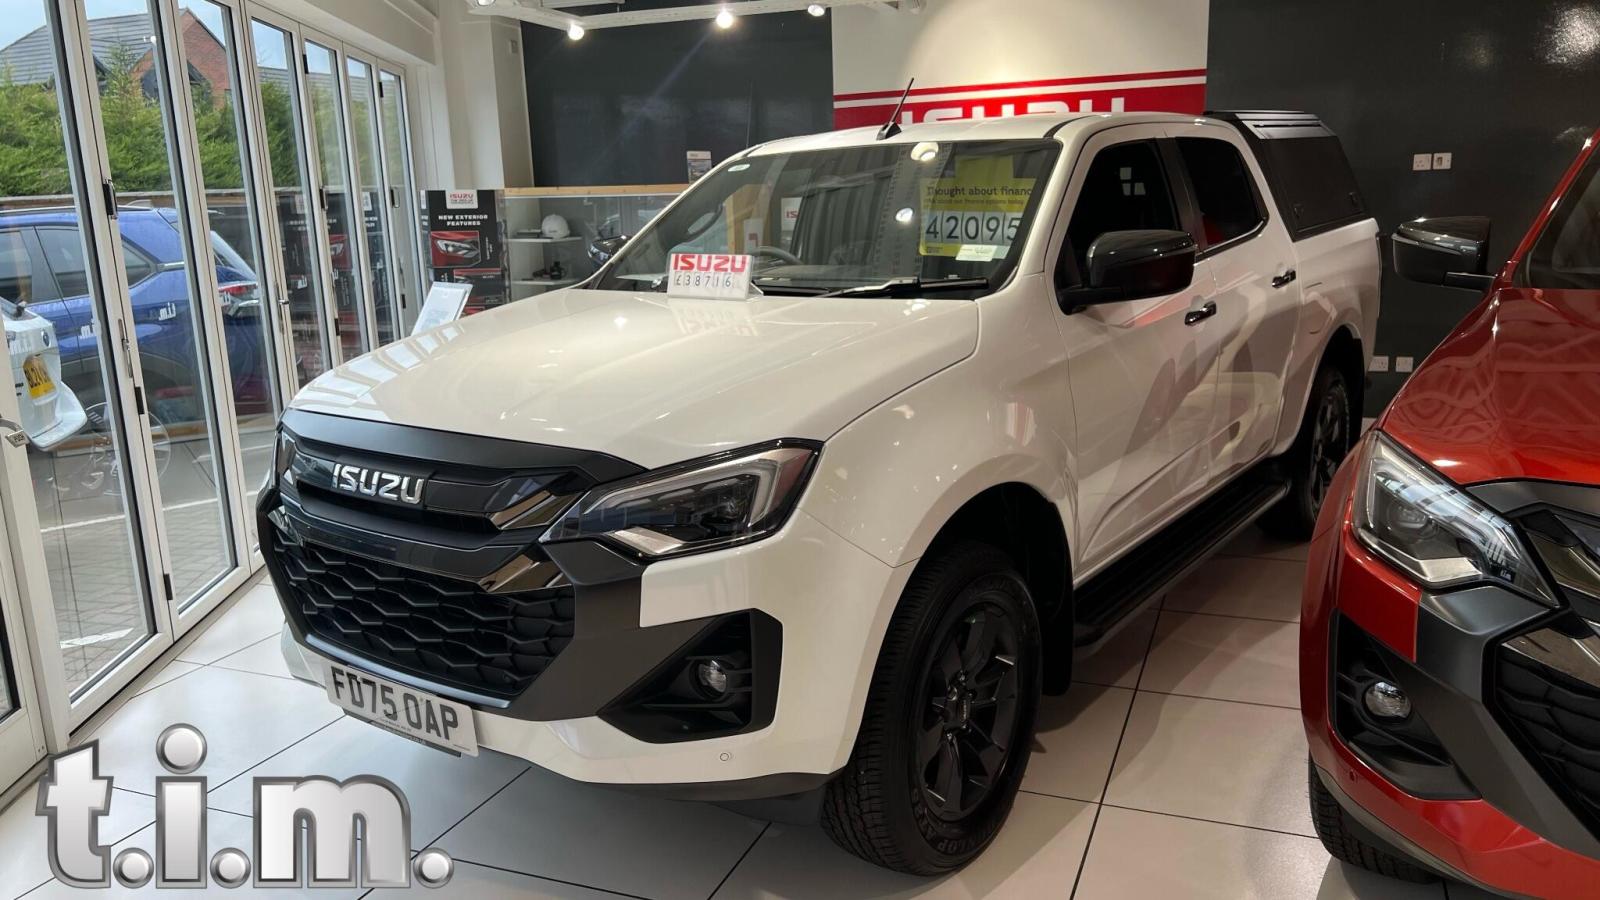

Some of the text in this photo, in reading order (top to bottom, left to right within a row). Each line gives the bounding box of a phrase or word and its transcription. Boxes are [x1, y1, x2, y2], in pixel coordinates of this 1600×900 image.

[969, 186, 997, 195] about
[1001, 186, 1031, 195] financ
[673, 254, 747, 272] ISUZU
[332, 463, 424, 504] ISUZU
[331, 666, 458, 740] FD75 OAP
